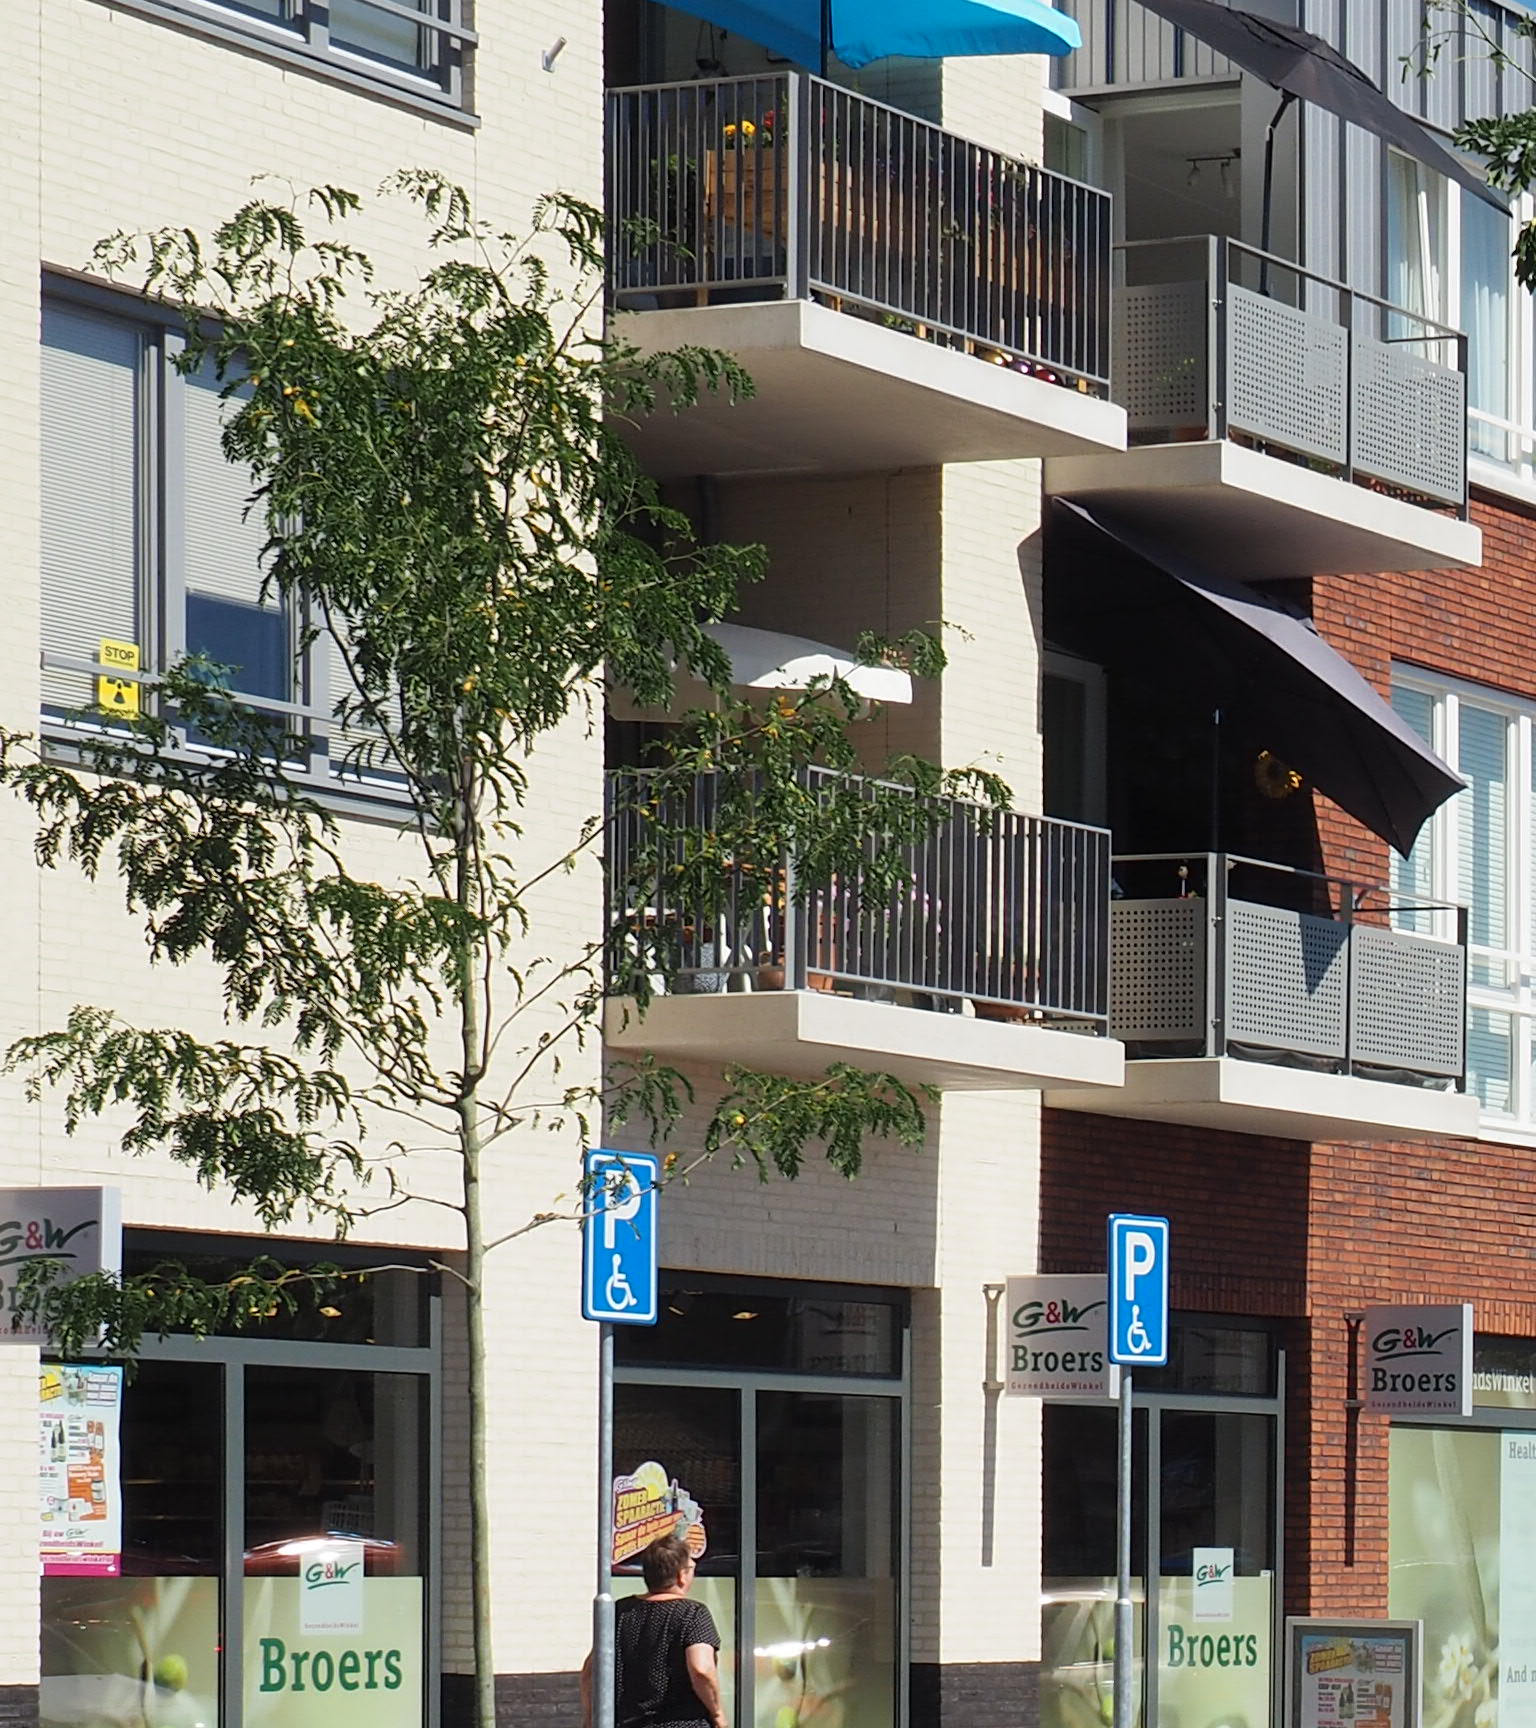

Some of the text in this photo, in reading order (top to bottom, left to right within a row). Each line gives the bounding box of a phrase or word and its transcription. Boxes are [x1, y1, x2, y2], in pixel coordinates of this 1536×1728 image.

[105, 645, 135, 661] STOP
[604, 1169, 642, 1249] P
[1125, 1231, 1156, 1301] P
[1012, 1299, 1107, 1328] G&W
[1372, 1326, 1460, 1353] G&W
[1011, 1344, 1104, 1373] Broers
[1371, 1367, 1457, 1393] Broers
[617, 1491, 646, 1510] ZOMER
[305, 1561, 360, 1584] G&W
[1196, 1564, 1232, 1582] G&W
[1167, 1624, 1258, 1669] Broers
[259, 1637, 403, 1693] Broers
[1506, 1665, 1528, 1683] And
